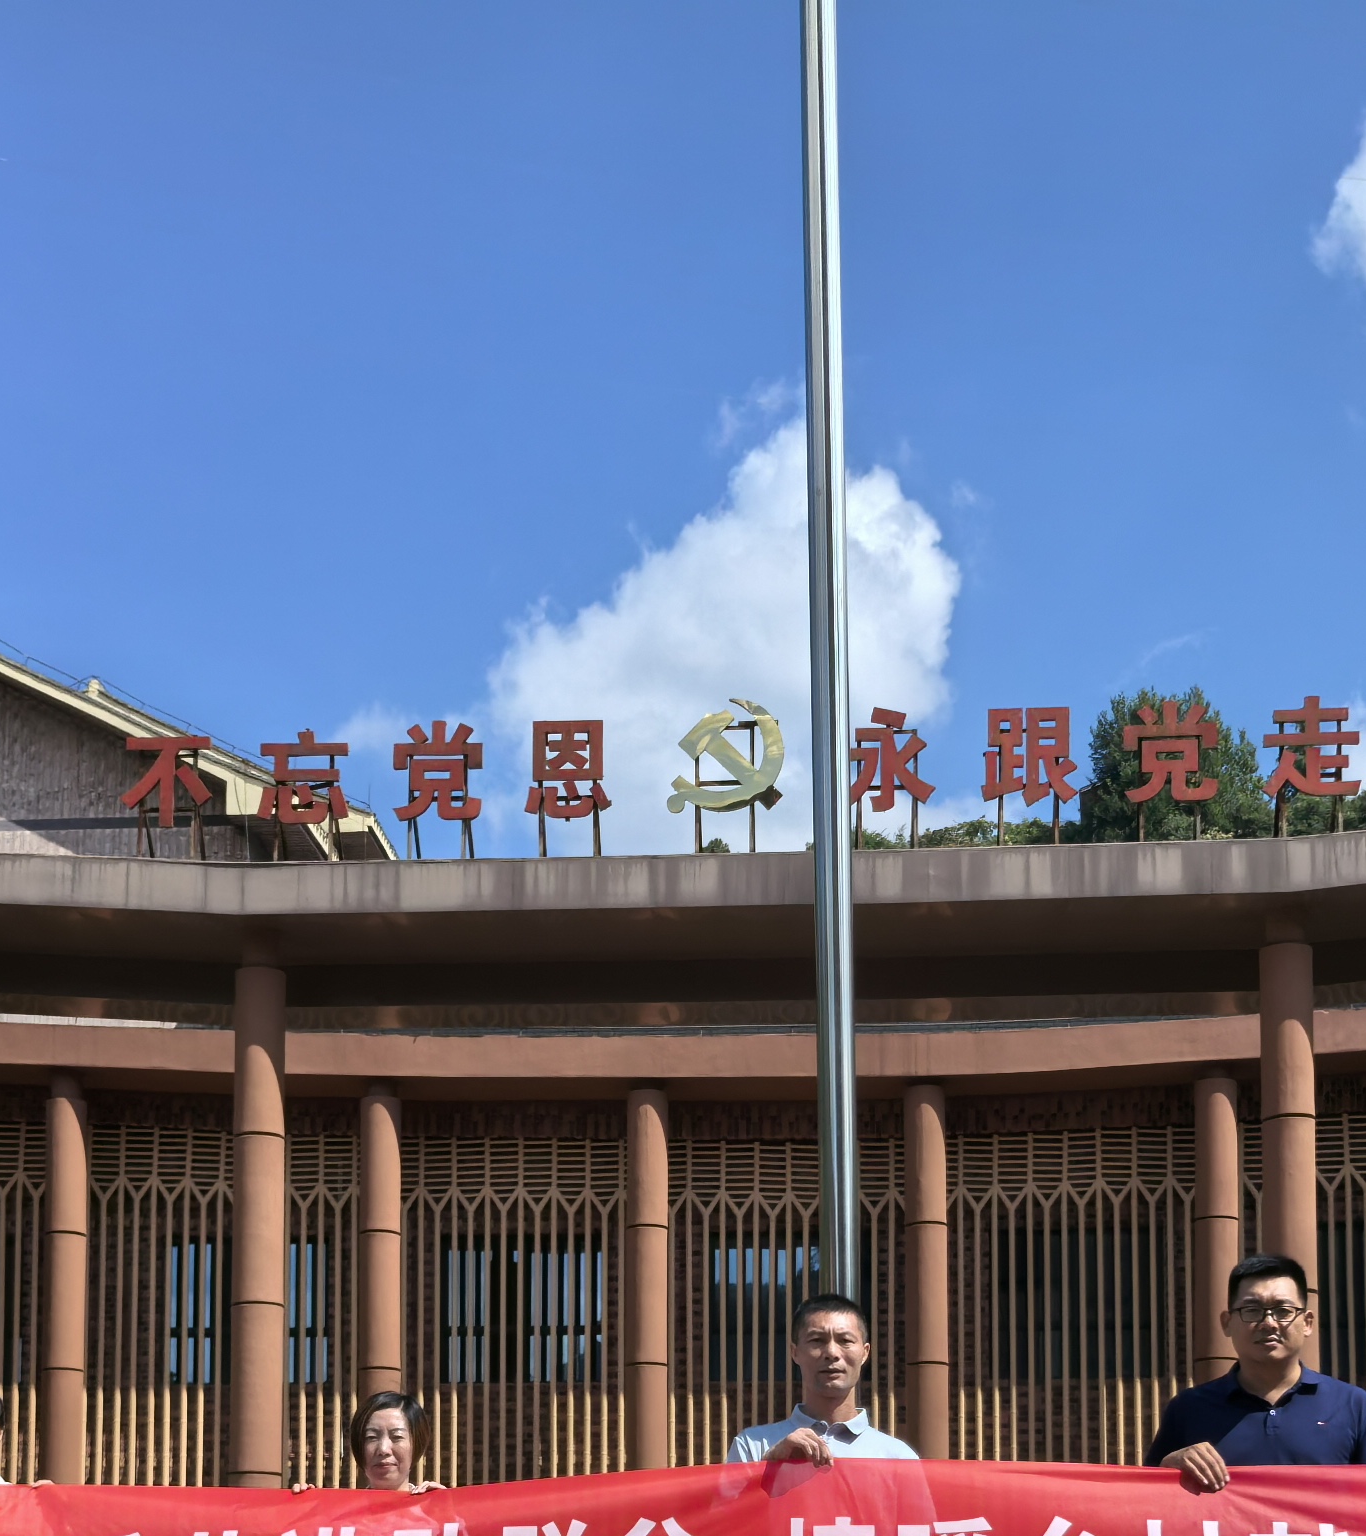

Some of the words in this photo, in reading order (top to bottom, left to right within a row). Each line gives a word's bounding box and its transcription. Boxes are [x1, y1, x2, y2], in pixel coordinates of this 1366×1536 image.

[122, 720, 611, 829] 不忘党恩
[850, 695, 1362, 813] 永跟党走
